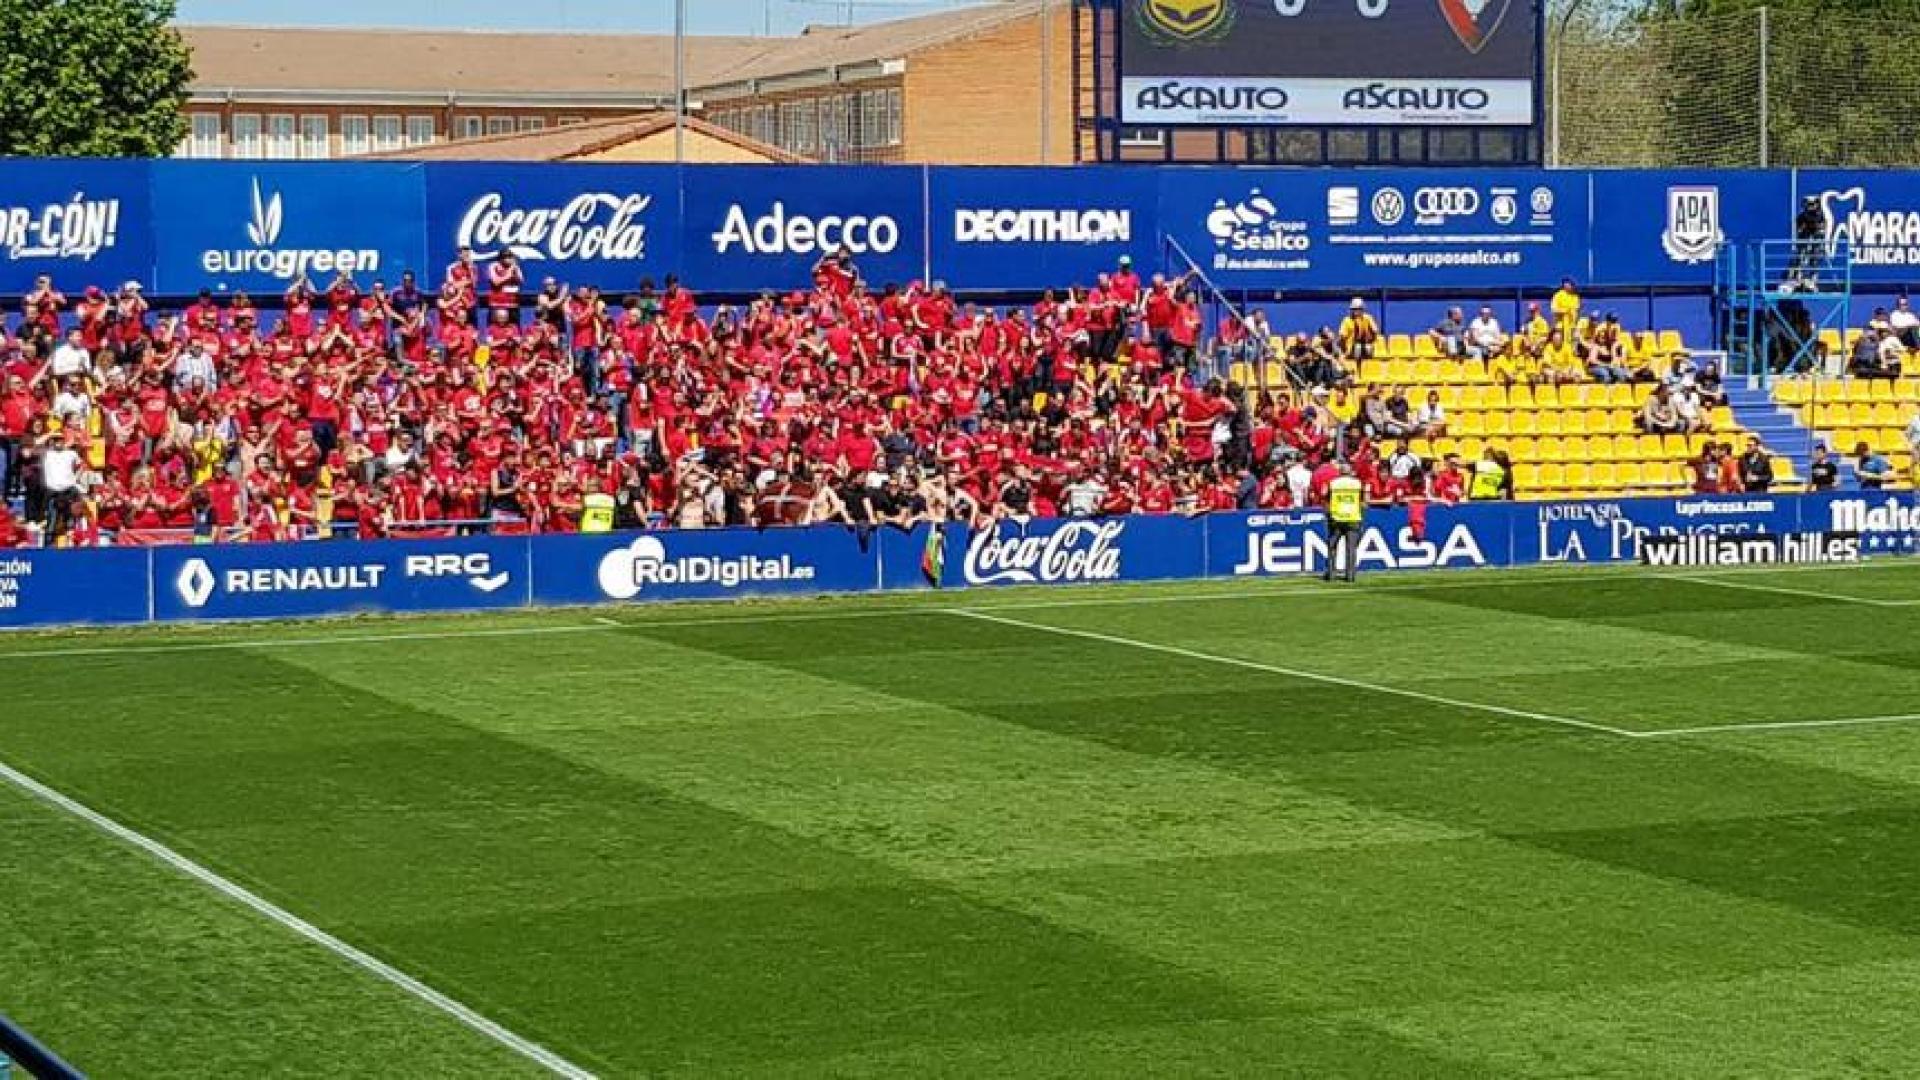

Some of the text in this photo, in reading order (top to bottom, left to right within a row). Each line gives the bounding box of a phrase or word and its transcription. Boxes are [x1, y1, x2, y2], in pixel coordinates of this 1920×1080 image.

[1138, 82, 1288, 110] ASCAUTO
[1343, 83, 1490, 110] ASCAUTO
[458, 192, 651, 260] Coca-Cola
[712, 202, 898, 254] Adecco
[955, 209, 1131, 242] DECATHLON
[203, 248, 380, 278] eurogreen
[1363, 250, 1521, 269] www.gruposealco.es
[1539, 521, 1587, 561] LA
[1644, 533, 1776, 566] william
[1783, 532, 1858, 564] hill.es
[227, 564, 386, 592] RENAULT
[406, 552, 490, 577] RRG
[634, 552, 816, 587] RolDigital.es
